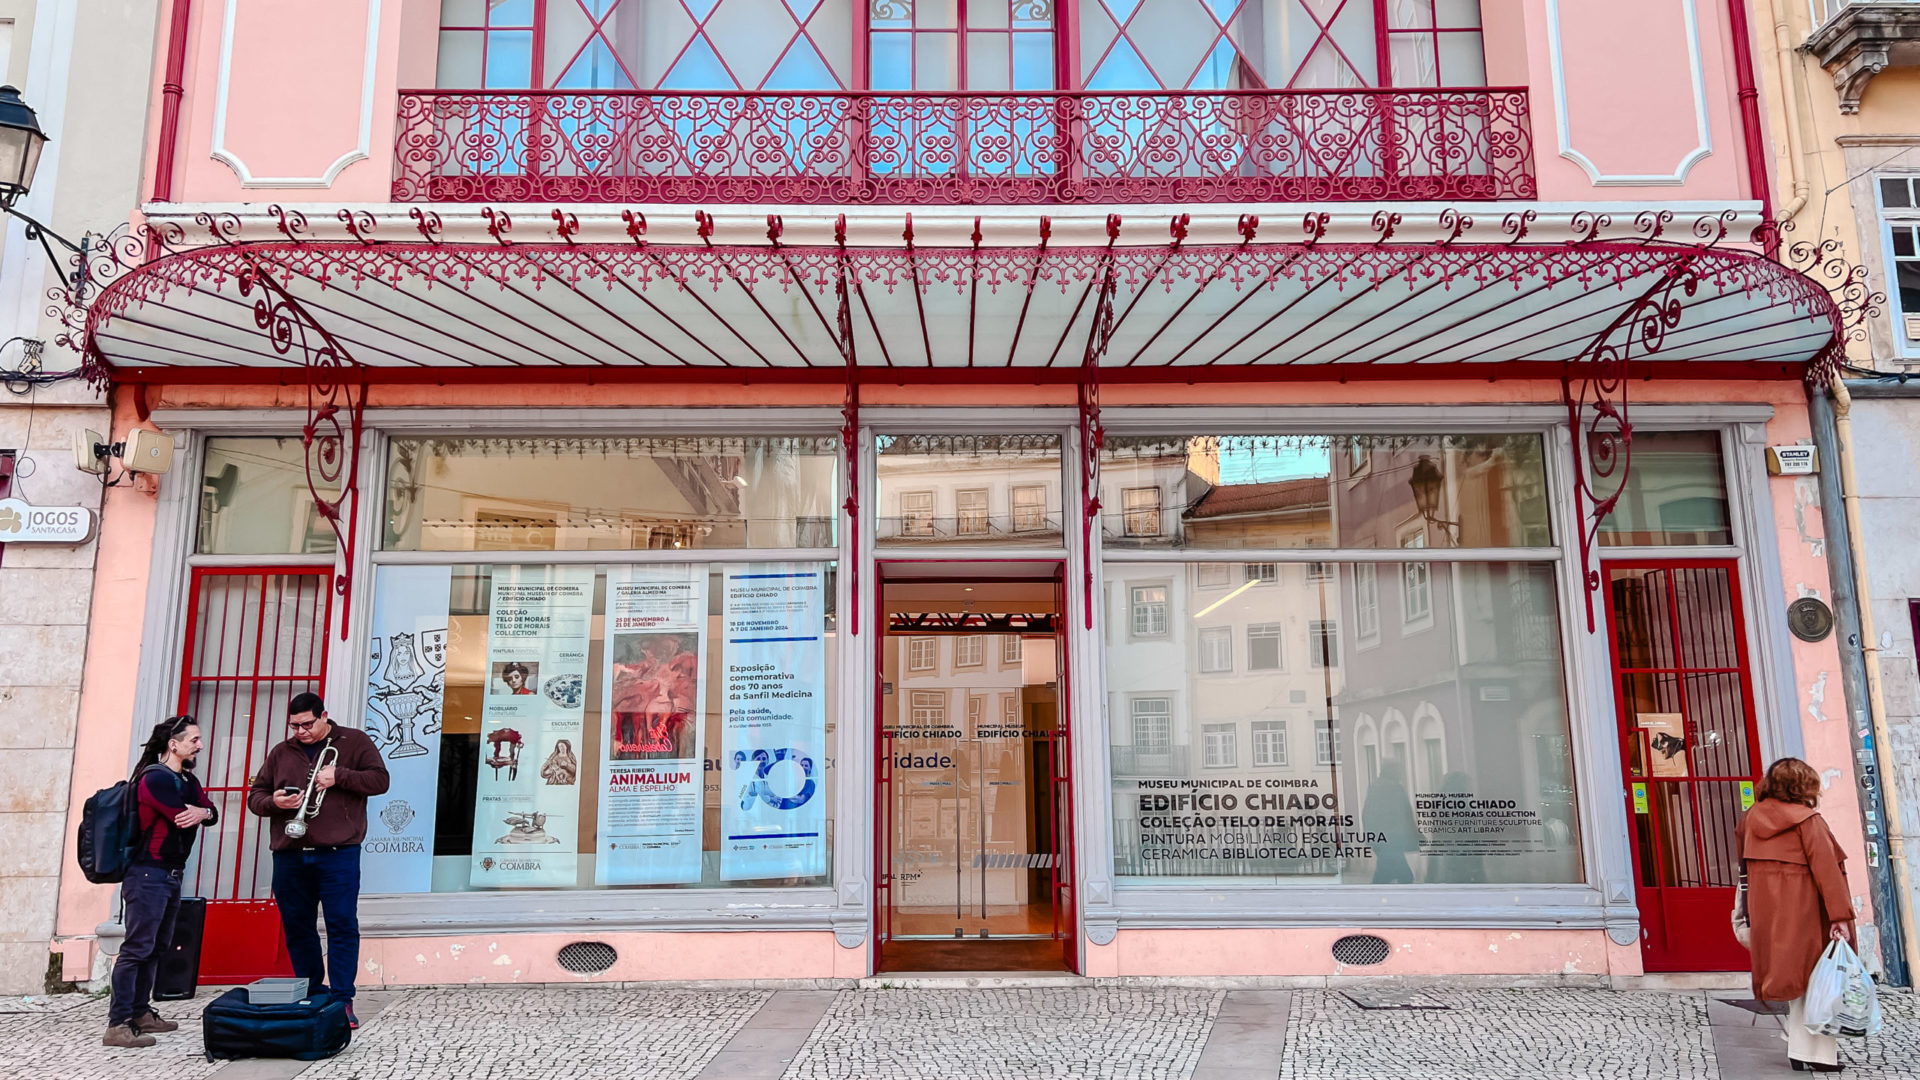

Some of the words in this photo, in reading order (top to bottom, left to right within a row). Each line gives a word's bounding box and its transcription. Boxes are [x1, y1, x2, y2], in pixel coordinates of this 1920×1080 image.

[26, 512, 78, 529] JOGOS
[730, 664, 775, 673] Exposição
[730, 672, 794, 681] comemorativa
[977, 728, 1018, 738] EDIFÍCIO
[609, 773, 690, 785] ANIMALIUM
[729, 748, 818, 810] 70
[1138, 780, 1178, 789] MUSEU
[1181, 780, 1244, 789] MUNICIPAL
[1247, 780, 1262, 788] DE
[1265, 779, 1318, 788] COIMBRA
[1140, 789, 1238, 811] EDIFÍCIO
[1245, 793, 1338, 811] CHIADO
[1416, 798, 1466, 809] EDIFÍCIO
[1469, 800, 1516, 809] CHIADO
[1140, 813, 1216, 832] COLEÇÃO
[1220, 817, 1260, 828] TELO
[1265, 816, 1285, 827] DE
[1290, 815, 1354, 827] MORAIS
[1142, 834, 1206, 845] PINTURA
[1211, 830, 1298, 844] MOBILIÁRIO
[1302, 832, 1387, 843] ESCULTURA
[365, 842, 424, 853] COIMBRA
[1223, 847, 1307, 859] BIBLIOTECA
[1312, 847, 1330, 858] DE
[1334, 847, 1372, 858] ARTE
